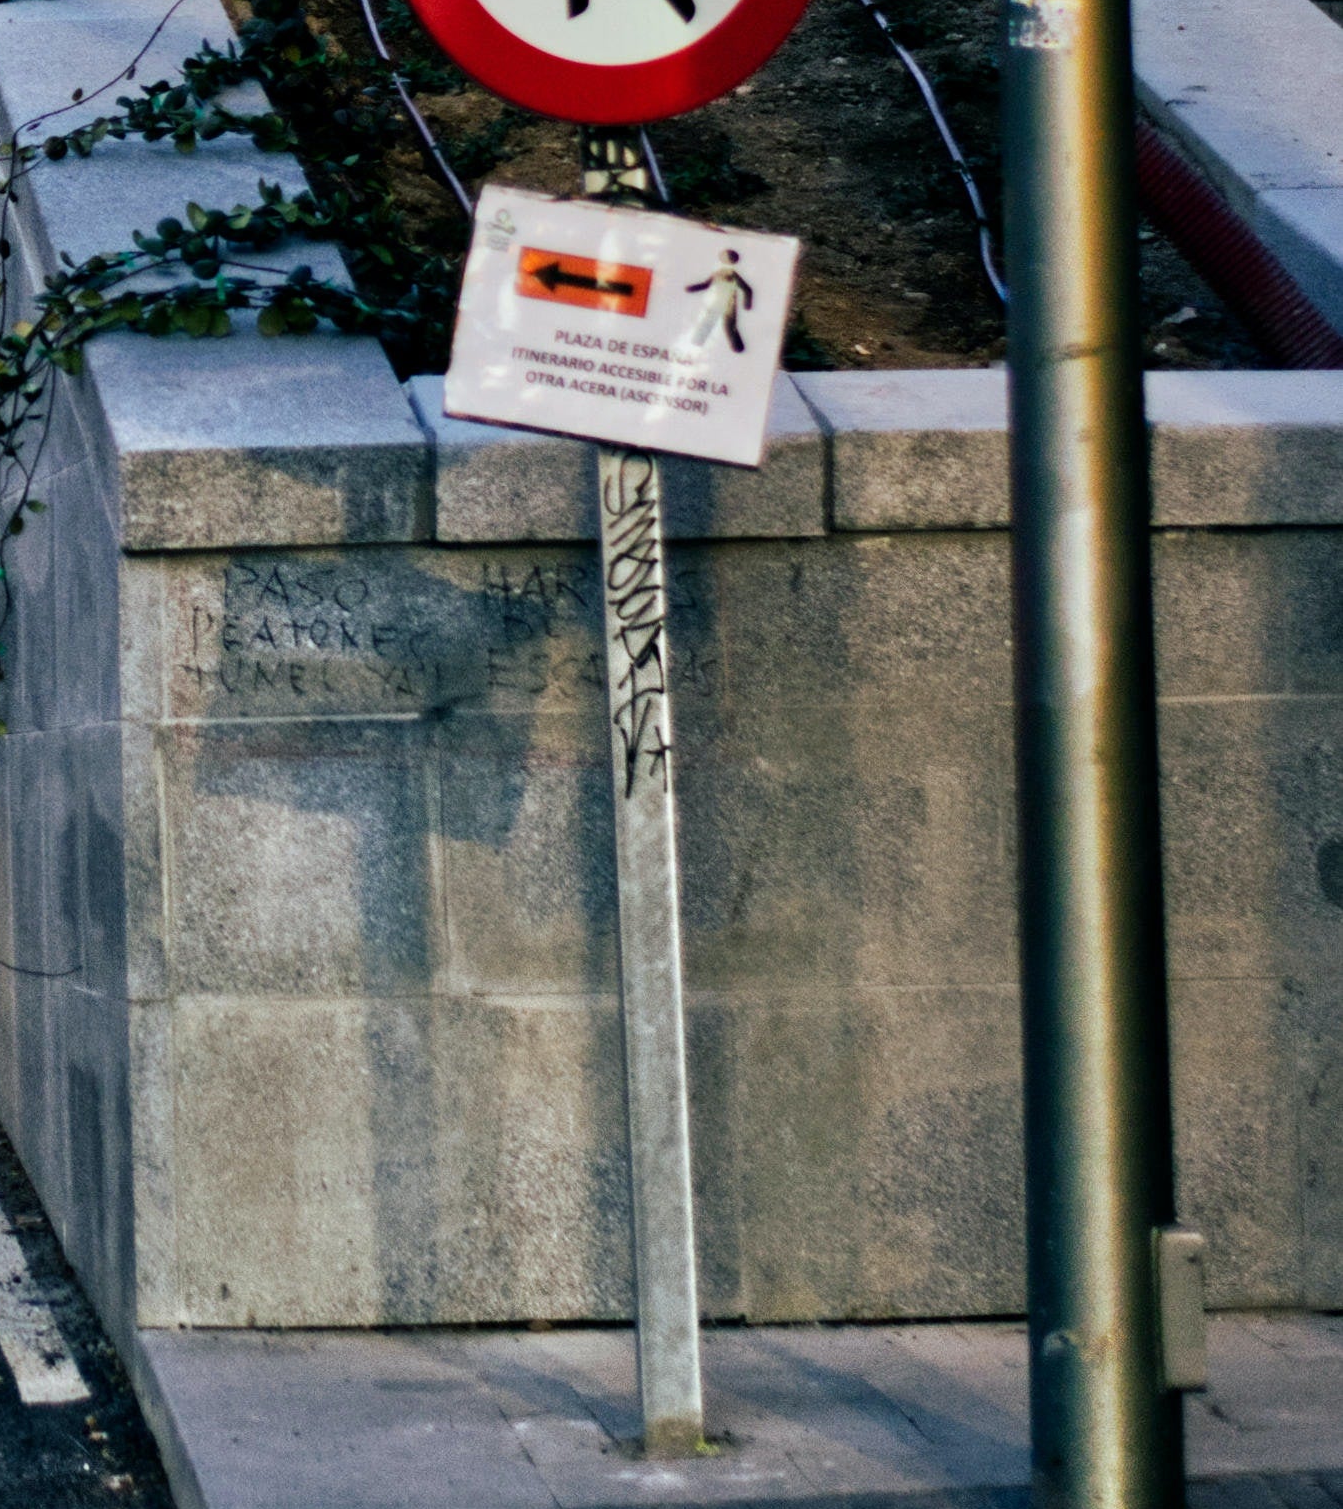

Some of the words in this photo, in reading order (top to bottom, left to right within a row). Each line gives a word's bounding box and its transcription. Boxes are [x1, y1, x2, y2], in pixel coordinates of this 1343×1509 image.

[554, 330, 602, 351] PLAZA
[608, 339, 627, 355] DE
[512, 346, 595, 373] ITINERARIO
[711, 383, 728, 397] LA
[525, 370, 565, 389] OTRA
[570, 379, 616, 398] ACERA
[224, 562, 369, 612] PASO
